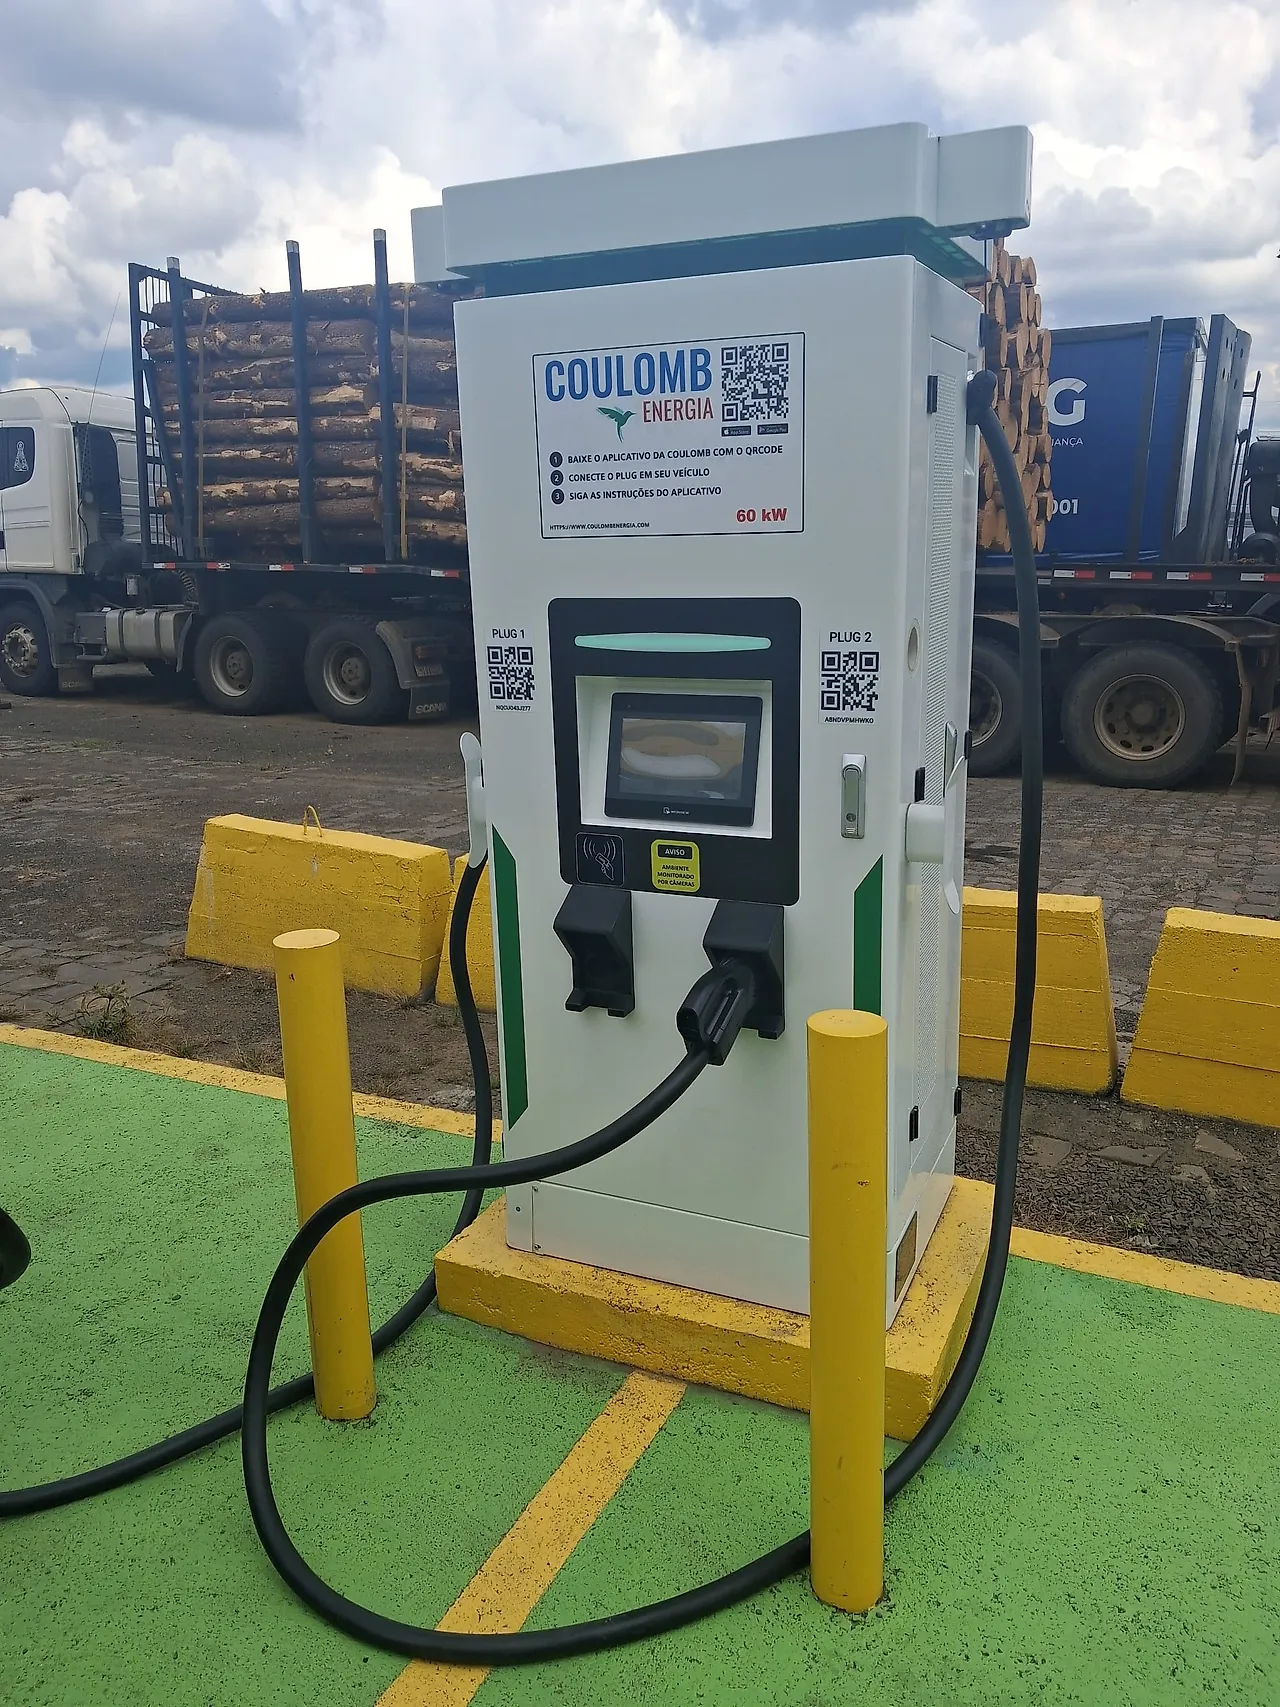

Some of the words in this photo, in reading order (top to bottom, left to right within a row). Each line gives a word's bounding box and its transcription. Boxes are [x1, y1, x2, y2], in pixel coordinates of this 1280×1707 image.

[545, 349, 712, 402] COULOMB
[1047, 377, 1088, 426] G
[643, 397, 714, 423] ENERGIA
[567, 455, 593, 464] BAIXE
[594, 454, 600, 462] O
[602, 452, 651, 462] APLICATIVO
[653, 451, 665, 459] DA
[667, 449, 711, 458] COULOMB
[713, 448, 734, 457] COM
[736, 447, 743, 455] O
[745, 445, 783, 456] QRCODE
[568, 472, 605, 482] CONECTE
[607, 472, 613, 480] O
[615, 471, 637, 480] PLUG
[640, 470, 652, 479] EM
[654, 469, 671, 478] SEU
[672, 467, 710, 477] VEÍCULO
[569, 491, 588, 500] SIGA
[590, 491, 600, 499] AS
[603, 488, 654, 499] INSTRUÇÕES
[656, 488, 669, 497] DO
[670, 486, 722, 497] APLICATIVO
[736, 509, 756, 522] 60
[761, 508, 787, 521] kW
[492, 629, 517, 638] PLUG
[520, 629, 524, 638] 1
[829, 631, 861, 642] PLUG
[865, 631, 872, 642] 2
[664, 848, 685, 856] AVISO
[657, 871, 695, 880] MONITORADO
